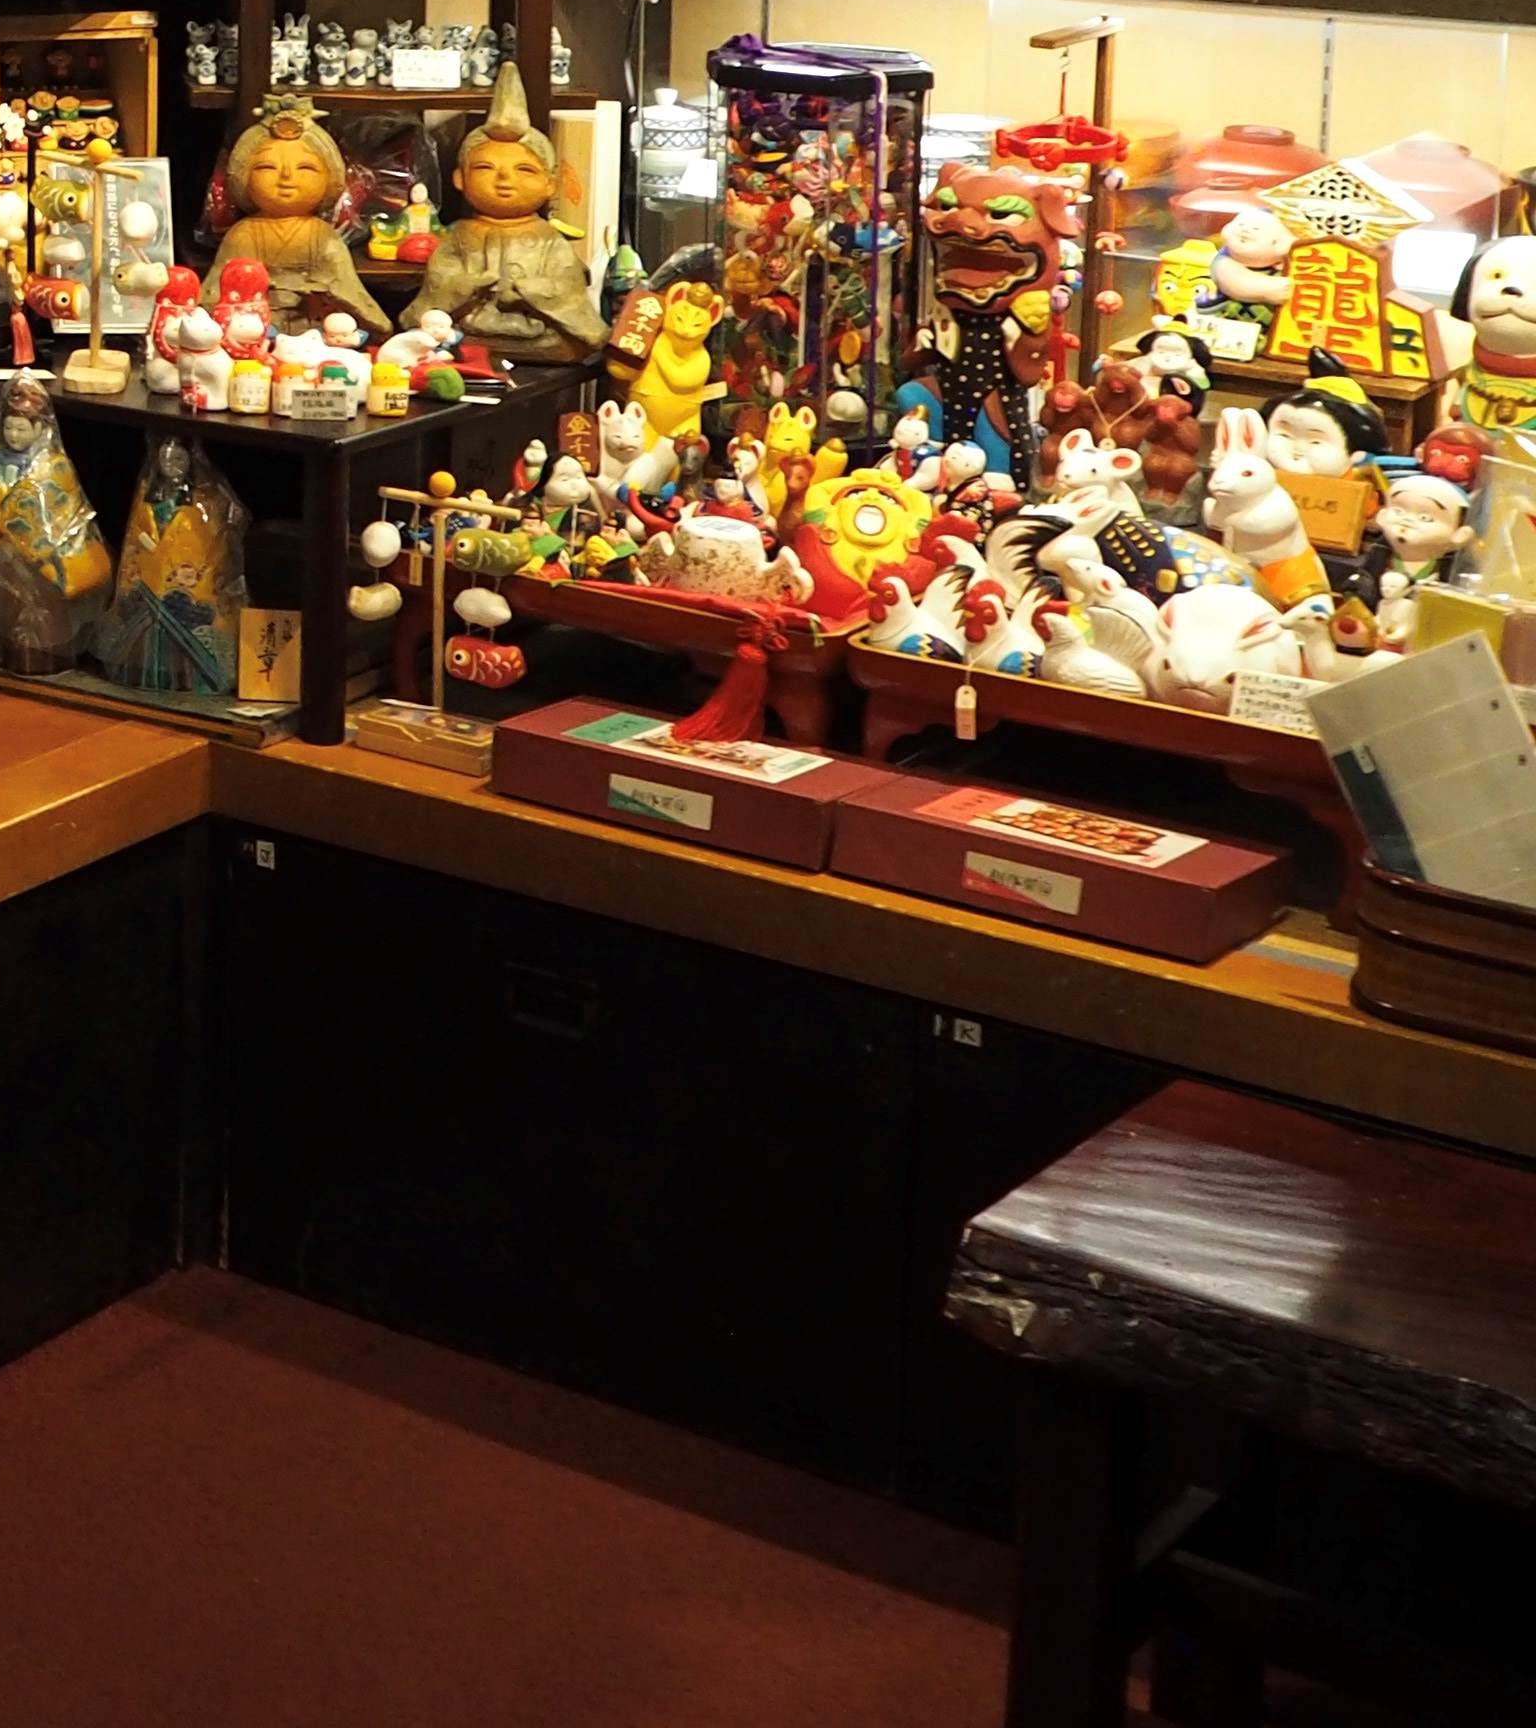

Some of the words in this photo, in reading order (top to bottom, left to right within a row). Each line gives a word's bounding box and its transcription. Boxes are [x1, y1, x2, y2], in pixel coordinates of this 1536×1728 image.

[618, 296, 664, 356] 金千両
[1280, 248, 1377, 368] 龍王
